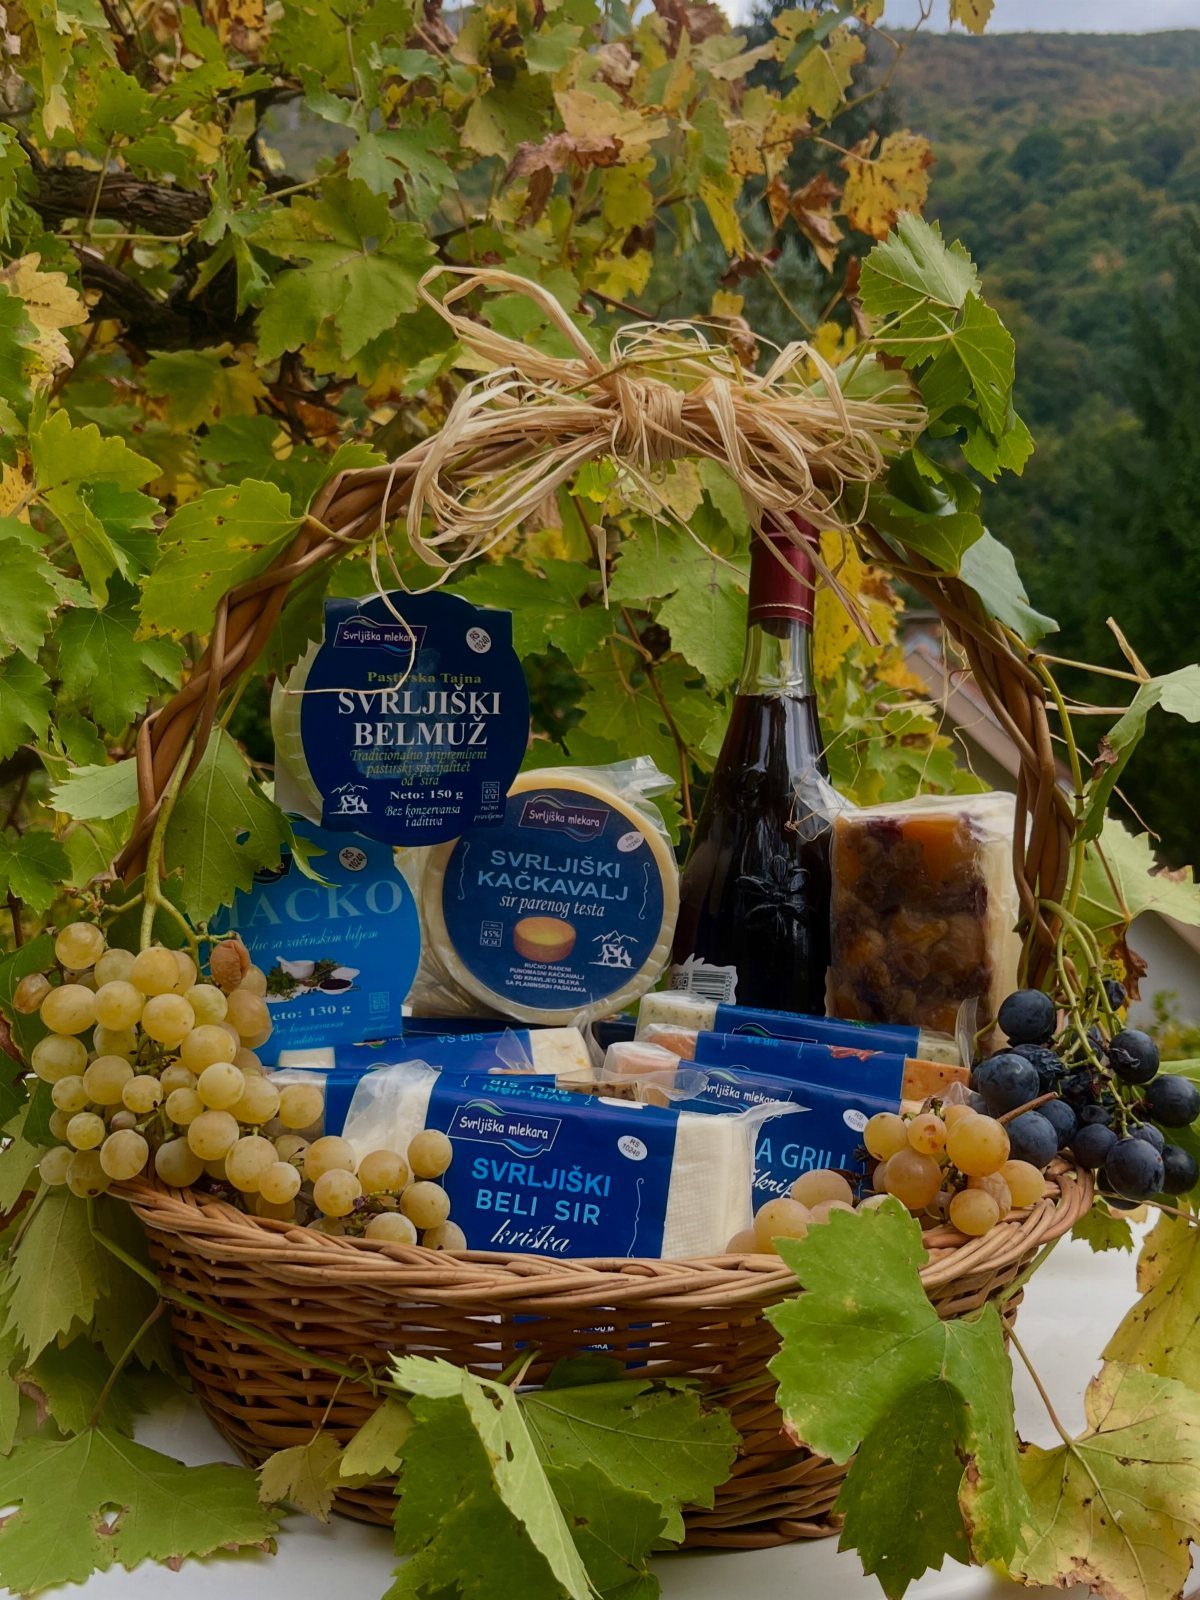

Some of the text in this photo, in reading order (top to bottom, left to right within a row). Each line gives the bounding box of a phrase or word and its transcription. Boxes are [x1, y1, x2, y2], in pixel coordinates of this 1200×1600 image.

[343, 630, 380, 643] Svrljiška
[367, 671, 482, 687] Pastirska Tajna
[338, 684, 502, 715] SVRLJIŠKI
[354, 715, 488, 746] BELMUŽ
[350, 747, 488, 764] Tradicionalno pripremljeni
[366, 761, 471, 778] pastirski specijalitet
[401, 775, 439, 786] od sira
[390, 790, 464, 800] Neto: 150 g
[385, 804, 460, 818] Bez konzervansa
[529, 809, 600, 828] Svrljiška mlekara
[411, 815, 443, 827] aditiva
[490, 850, 621, 878] SVRLJIŠKI
[477, 871, 629, 901] KAČKAVALJ
[499, 891, 605, 918] sir parenog testa
[272, 940, 282, 949] sa
[287, 927, 342, 947] začinskim
[345, 924, 379, 948] biljem
[548, 971, 585, 980] KAČKAVALJ
[272, 1005, 351, 1021] eto: 130 g
[437, 1033, 484, 1044] SIR SA
[459, 1116, 549, 1139] Svrljiška mlekara
[622, 1143, 641, 1157] 10240
[630, 1138, 640, 1148] RS
[755, 1138, 772, 1163] A
[471, 1157, 611, 1198] SVRLJIŠKI
[476, 1189, 600, 1226] BELI SIR
[491, 1219, 573, 1253] kriška
